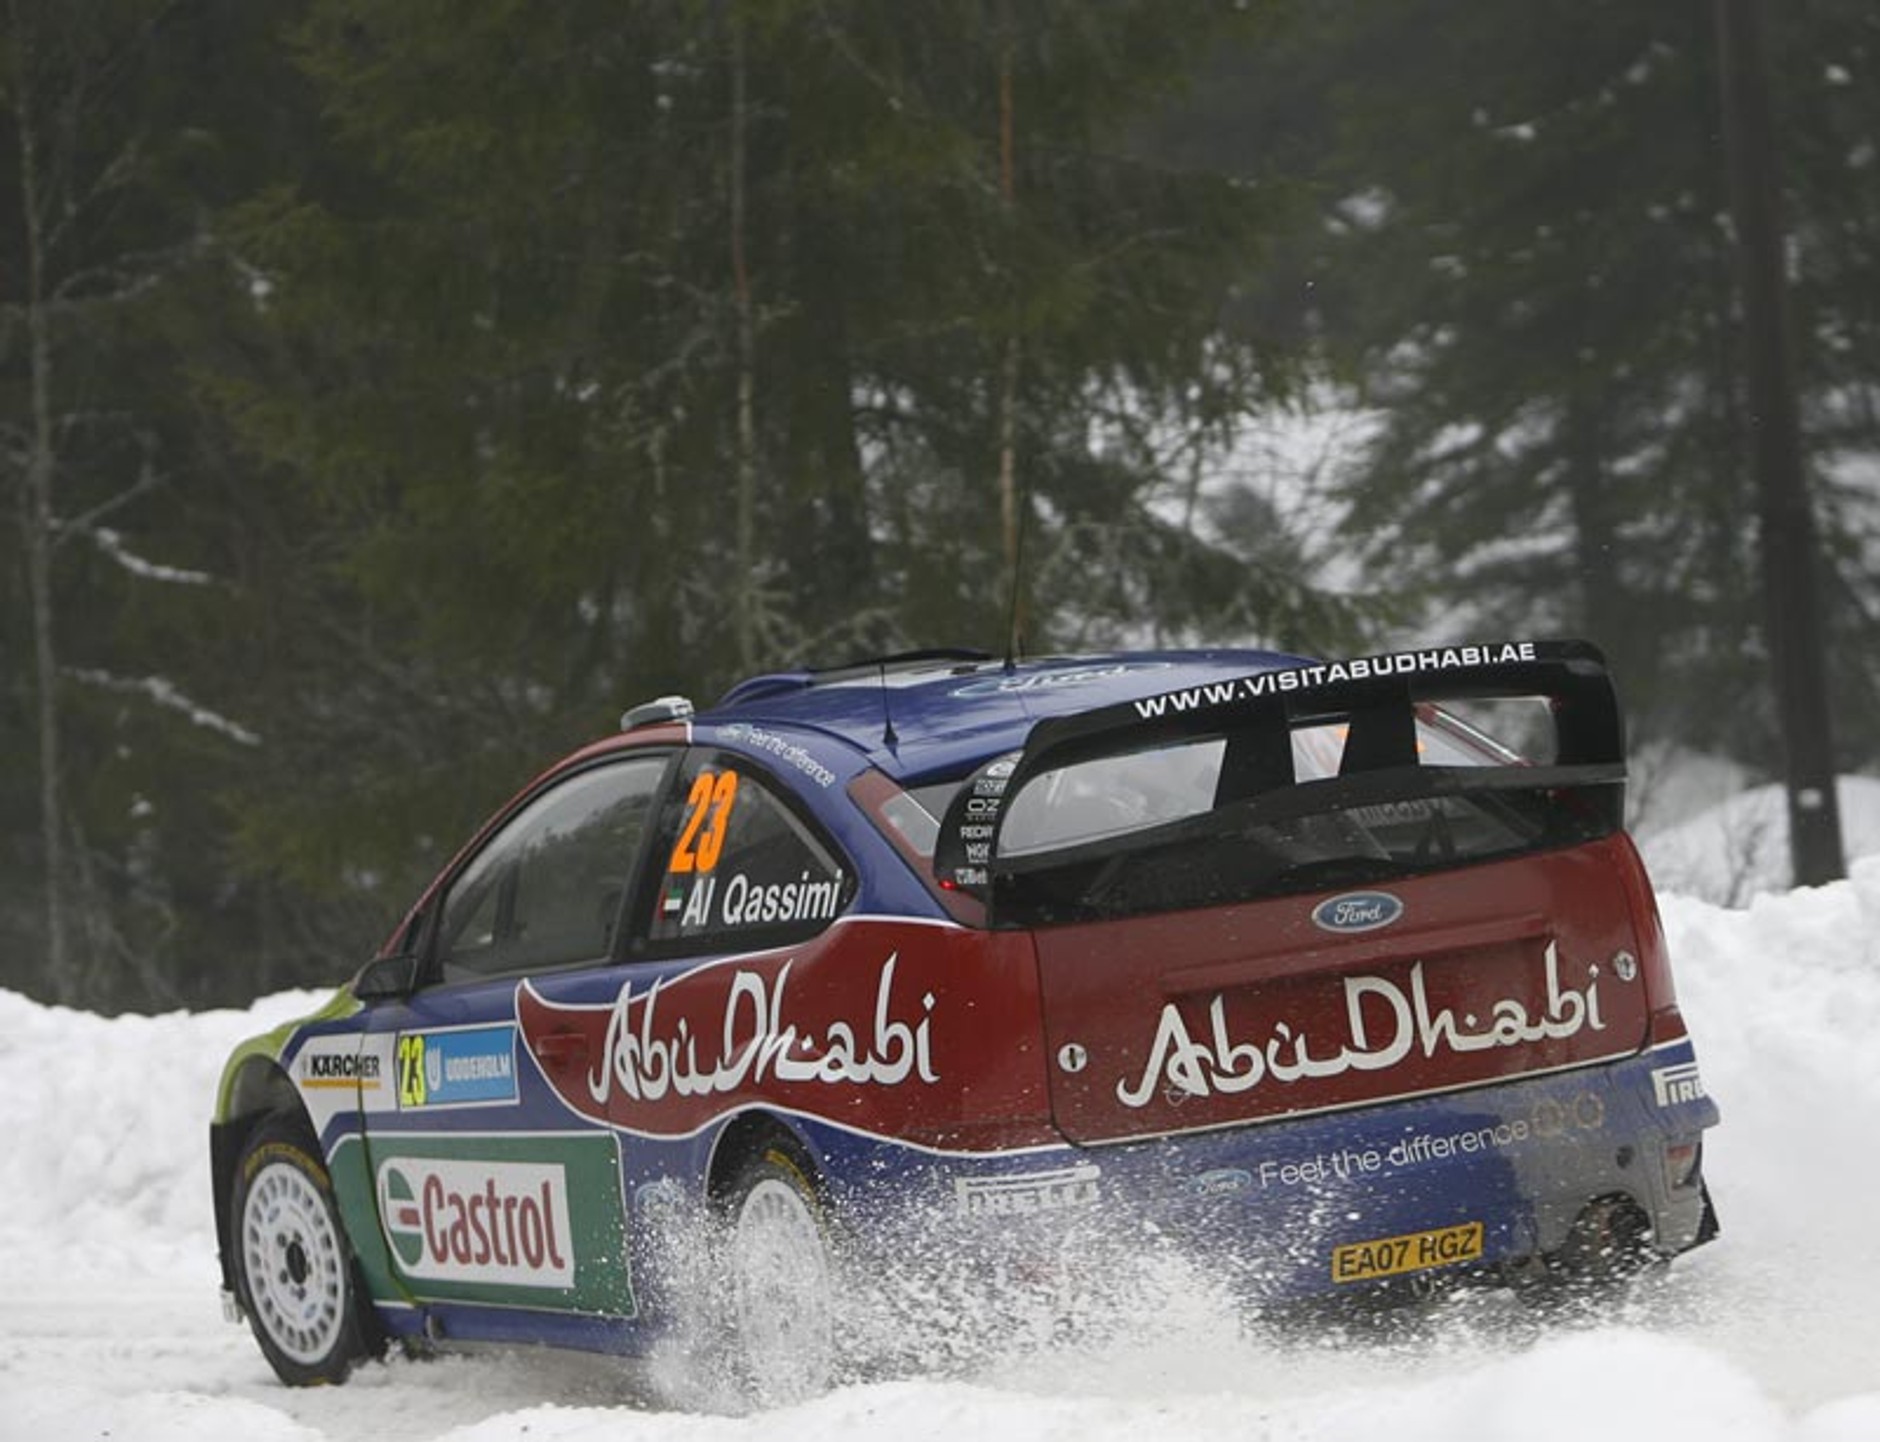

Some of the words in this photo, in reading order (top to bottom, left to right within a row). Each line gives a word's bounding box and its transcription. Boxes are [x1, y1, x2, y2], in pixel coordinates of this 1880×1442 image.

[1135, 643, 1537, 719] WWW.VISITABUDHABI.AE
[669, 769, 739, 873] 23
[681, 877, 716, 926] Al
[722, 868, 843, 925] Qassimi
[1333, 899, 1384, 925] Ford
[310, 1053, 380, 1078] KÄRCHER
[400, 1035, 426, 1107] 23
[1259, 1157, 1327, 1189] Feel
[1326, 1148, 1382, 1180] the
[1387, 1118, 1530, 1168] difference
[422, 1172, 566, 1271] Castrol
[1338, 1239, 1410, 1277] EA07
